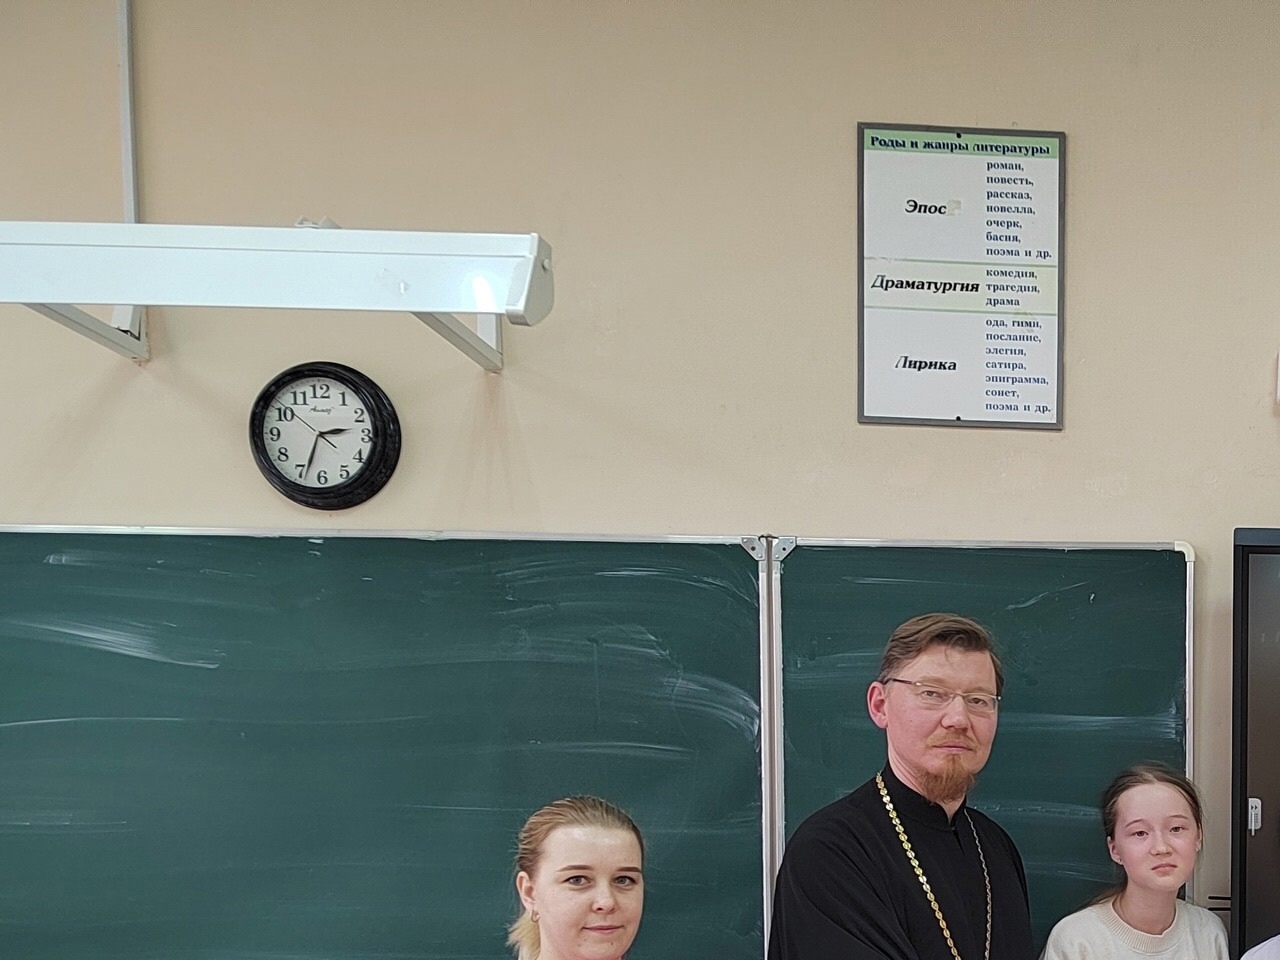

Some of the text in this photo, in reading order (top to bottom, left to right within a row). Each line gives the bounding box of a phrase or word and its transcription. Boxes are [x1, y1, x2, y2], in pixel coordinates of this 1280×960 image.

[871, 136, 1050, 155] Роды и жанры литературы
[986, 162, 1024, 171] роман,
[986, 176, 1034, 186] повесть,
[986, 190, 1032, 200] рассказ,
[904, 200, 947, 215] Эпос
[986, 205, 1036, 215] новелла,
[986, 219, 1022, 229] очерк,
[986, 232, 1021, 243] басня,
[986, 248, 1020, 257] поэма
[1036, 250, 1052, 260] др.
[986, 269, 1038, 279] комедия,
[871, 275, 980, 294] Драматургия
[986, 283, 1040, 294] трагедия,
[986, 298, 1020, 307] драма
[986, 319, 1042, 329] ода, гимн,
[986, 332, 1042, 343] послание,
[985, 348, 1026, 357] элегия,
[895, 356, 957, 372] Лирика
[985, 361, 1026, 370] сатира,
[985, 376, 1049, 386] эпиграмма,
[310, 384, 330, 398] 12
[985, 389, 1020, 398] сонет,
[291, 391, 309, 405] 11
[339, 392, 348, 406] 1
[276, 407, 294, 421] 10
[985, 403, 1051, 414] поэма и др.
[354, 408, 364, 422] 2
[270, 427, 280, 441] 9
[362, 428, 371, 443] 3
[278, 447, 289, 461] 8
[353, 448, 364, 463] 4
[295, 464, 306, 478] 7
[317, 470, 328, 484] 6
[340, 464, 350, 479] 5
